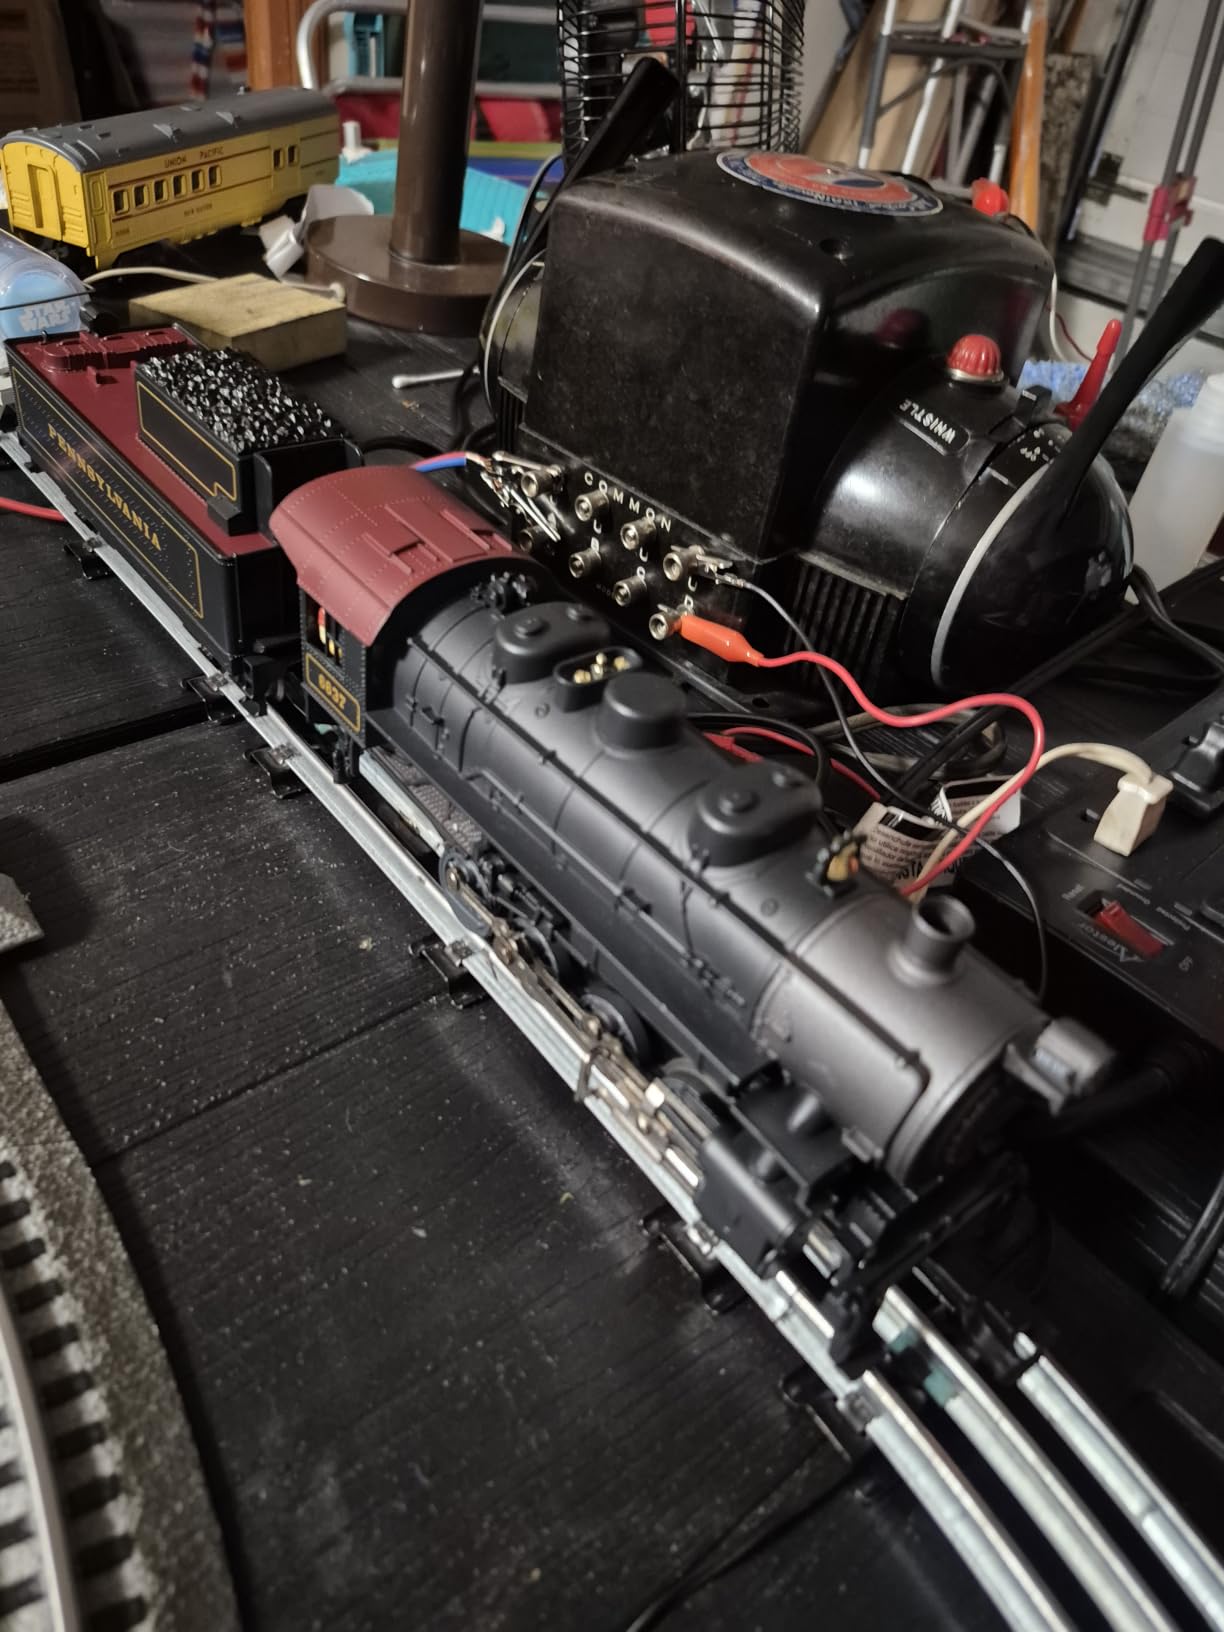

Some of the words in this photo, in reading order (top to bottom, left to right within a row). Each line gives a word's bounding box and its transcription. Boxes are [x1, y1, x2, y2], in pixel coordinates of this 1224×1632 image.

[165, 156, 186, 168] UNION
[200, 147, 223, 159] PACIFIC
[19, 312, 71, 333] WARS
[23, 301, 71, 319] STAR
[899, 400, 956, 445] WHISTLE
[47, 423, 162, 552] PENNSYLVANIA
[584, 471, 671, 533] COMMON
